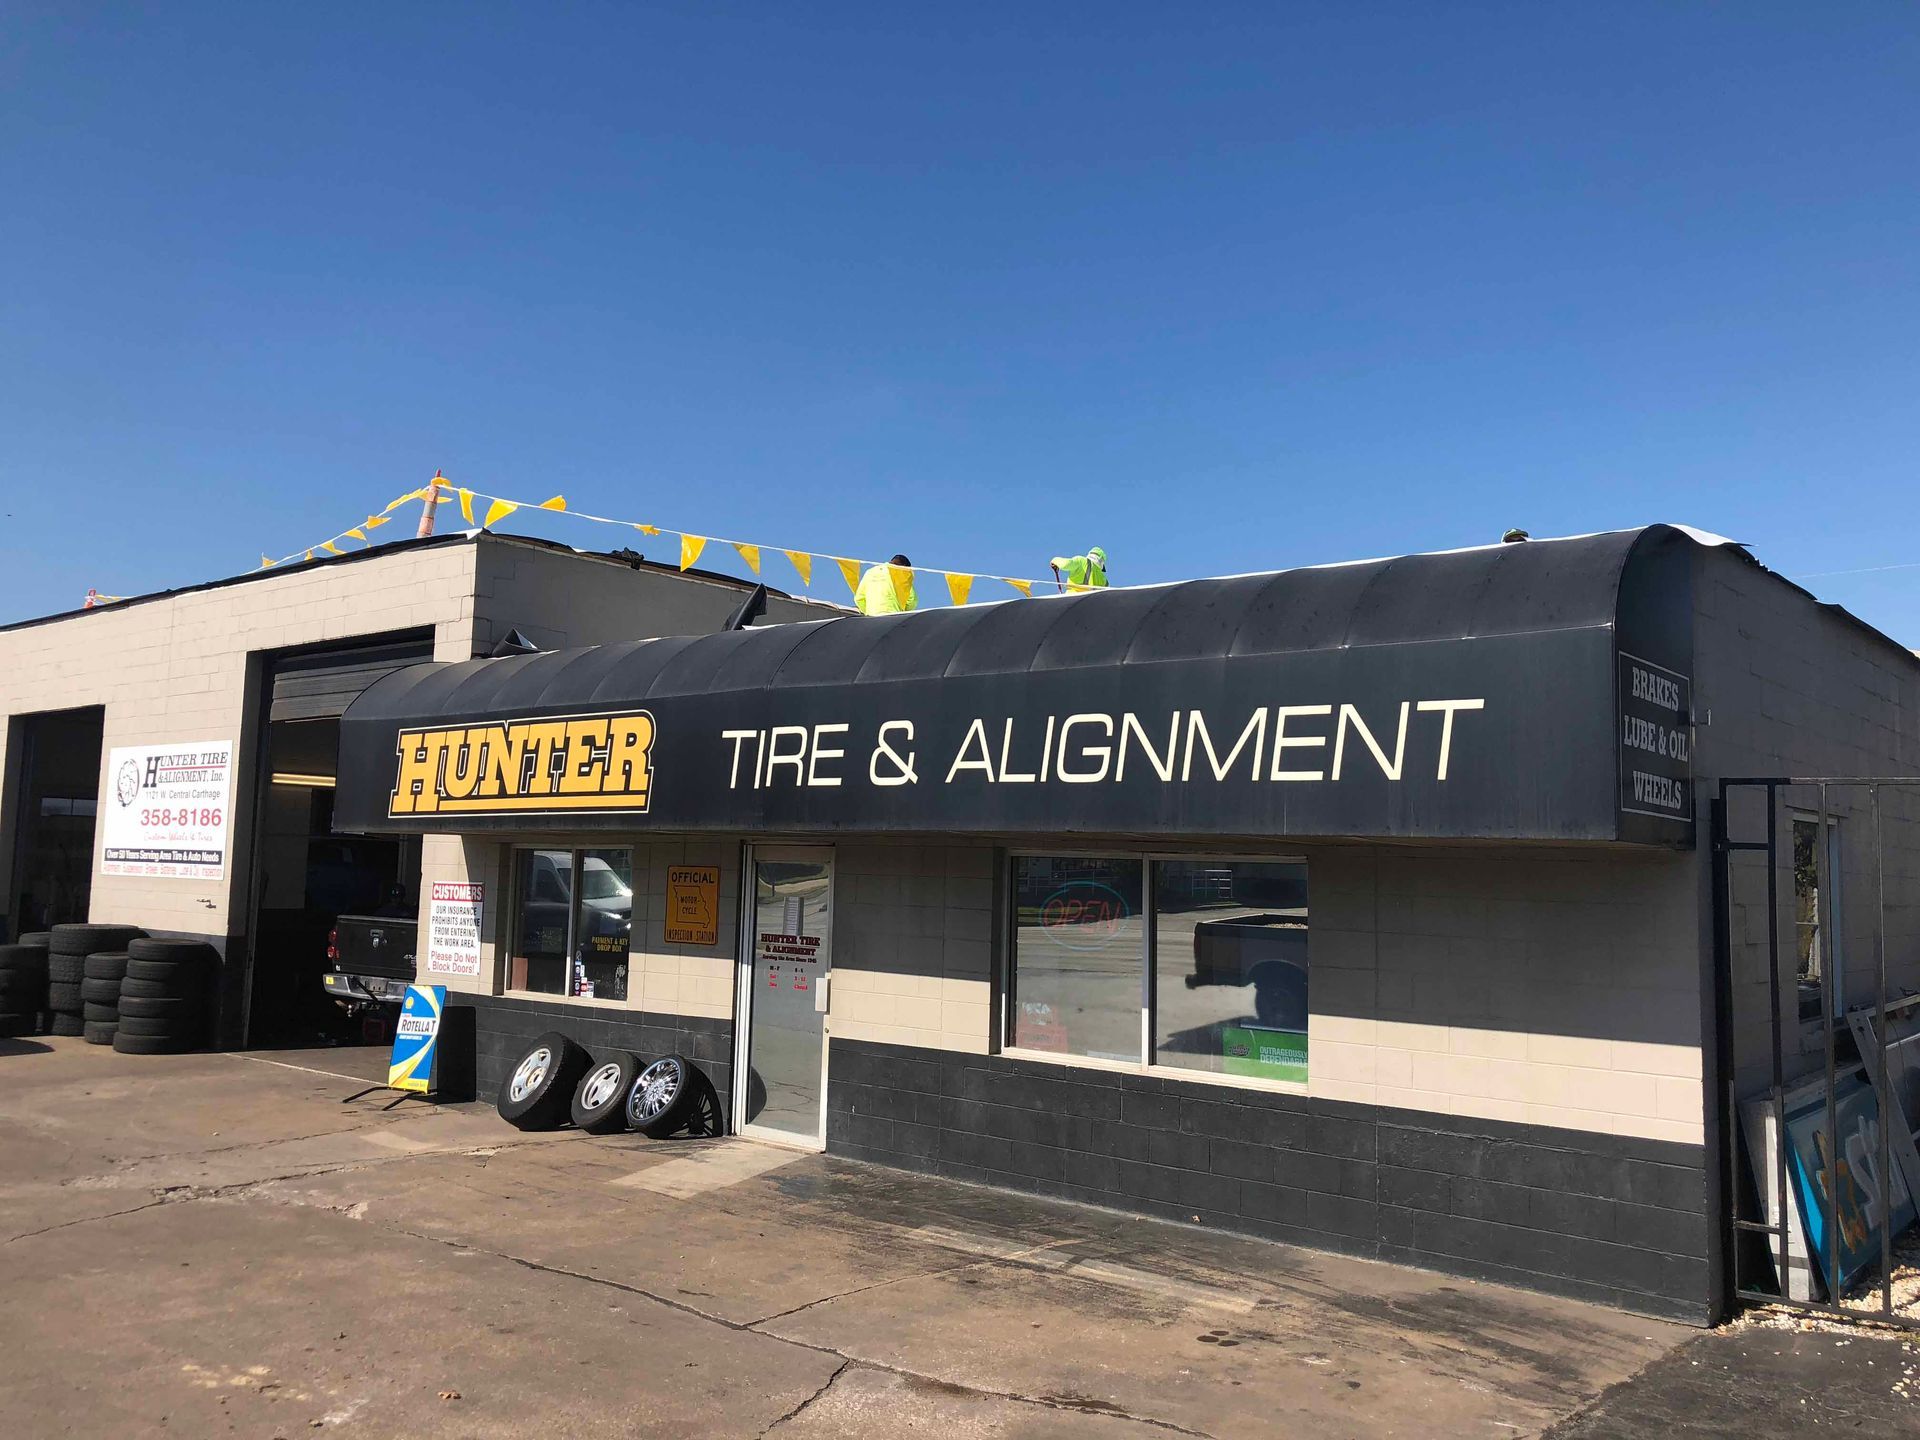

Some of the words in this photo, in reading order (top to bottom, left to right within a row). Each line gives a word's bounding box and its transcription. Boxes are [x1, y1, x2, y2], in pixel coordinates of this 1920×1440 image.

[1632, 666, 1679, 712] BRAKES
[722, 723, 849, 789] TIRE
[869, 719, 918, 786] &
[945, 698, 1485, 783] ALIGNMENT
[1624, 715, 1656, 752] LUBE
[1658, 726, 1666, 756] &
[1669, 730, 1688, 762] OIL
[142, 754, 197, 788] HUNTER
[201, 752, 228, 765] TIRE
[391, 716, 652, 812] HUNTER
[169, 790, 190, 799] Central
[192, 789, 221, 800] Carthage
[1632, 770, 1682, 810] WHEELS
[140, 808, 222, 826] 358-8186
[107, 850, 118, 859] Over
[126, 850, 139, 859] Years
[140, 850, 159, 861] Serving
[159, 851, 171, 860] Area
[172, 851, 182, 860] Tire
[183, 852, 188, 861] &
[188, 852, 201, 861] Auto
[202, 852, 219, 862] Needs
[672, 872, 714, 884] OFFICIAL
[434, 885, 482, 900] CUSTOMERS
[436, 905, 446, 914] OUR
[448, 906, 477, 916] INSURANCE
[1043, 899, 1121, 934] OPEN
[432, 916, 458, 926] PROHIBITS
[459, 917, 480, 927] ANYONE
[435, 926, 449, 936] FROM
[451, 928, 475, 938] ENTERING
[667, 928, 692, 940] INSPECTION
[434, 937, 443, 946] THE
[444, 938, 459, 947] WORK
[760, 933, 797, 945] HUNTER
[799, 936, 820, 946] TIRE
[431, 951, 452, 961] Please
[454, 953, 463, 962] Do
[465, 954, 477, 963] Not
[432, 961, 450, 971] Block
[452, 963, 474, 973] Doors!
[401, 1019, 429, 1032] ROTELLA
[430, 1021, 436, 1033] T
[1260, 1046, 1307, 1058] OUTRAGEOUSLY
